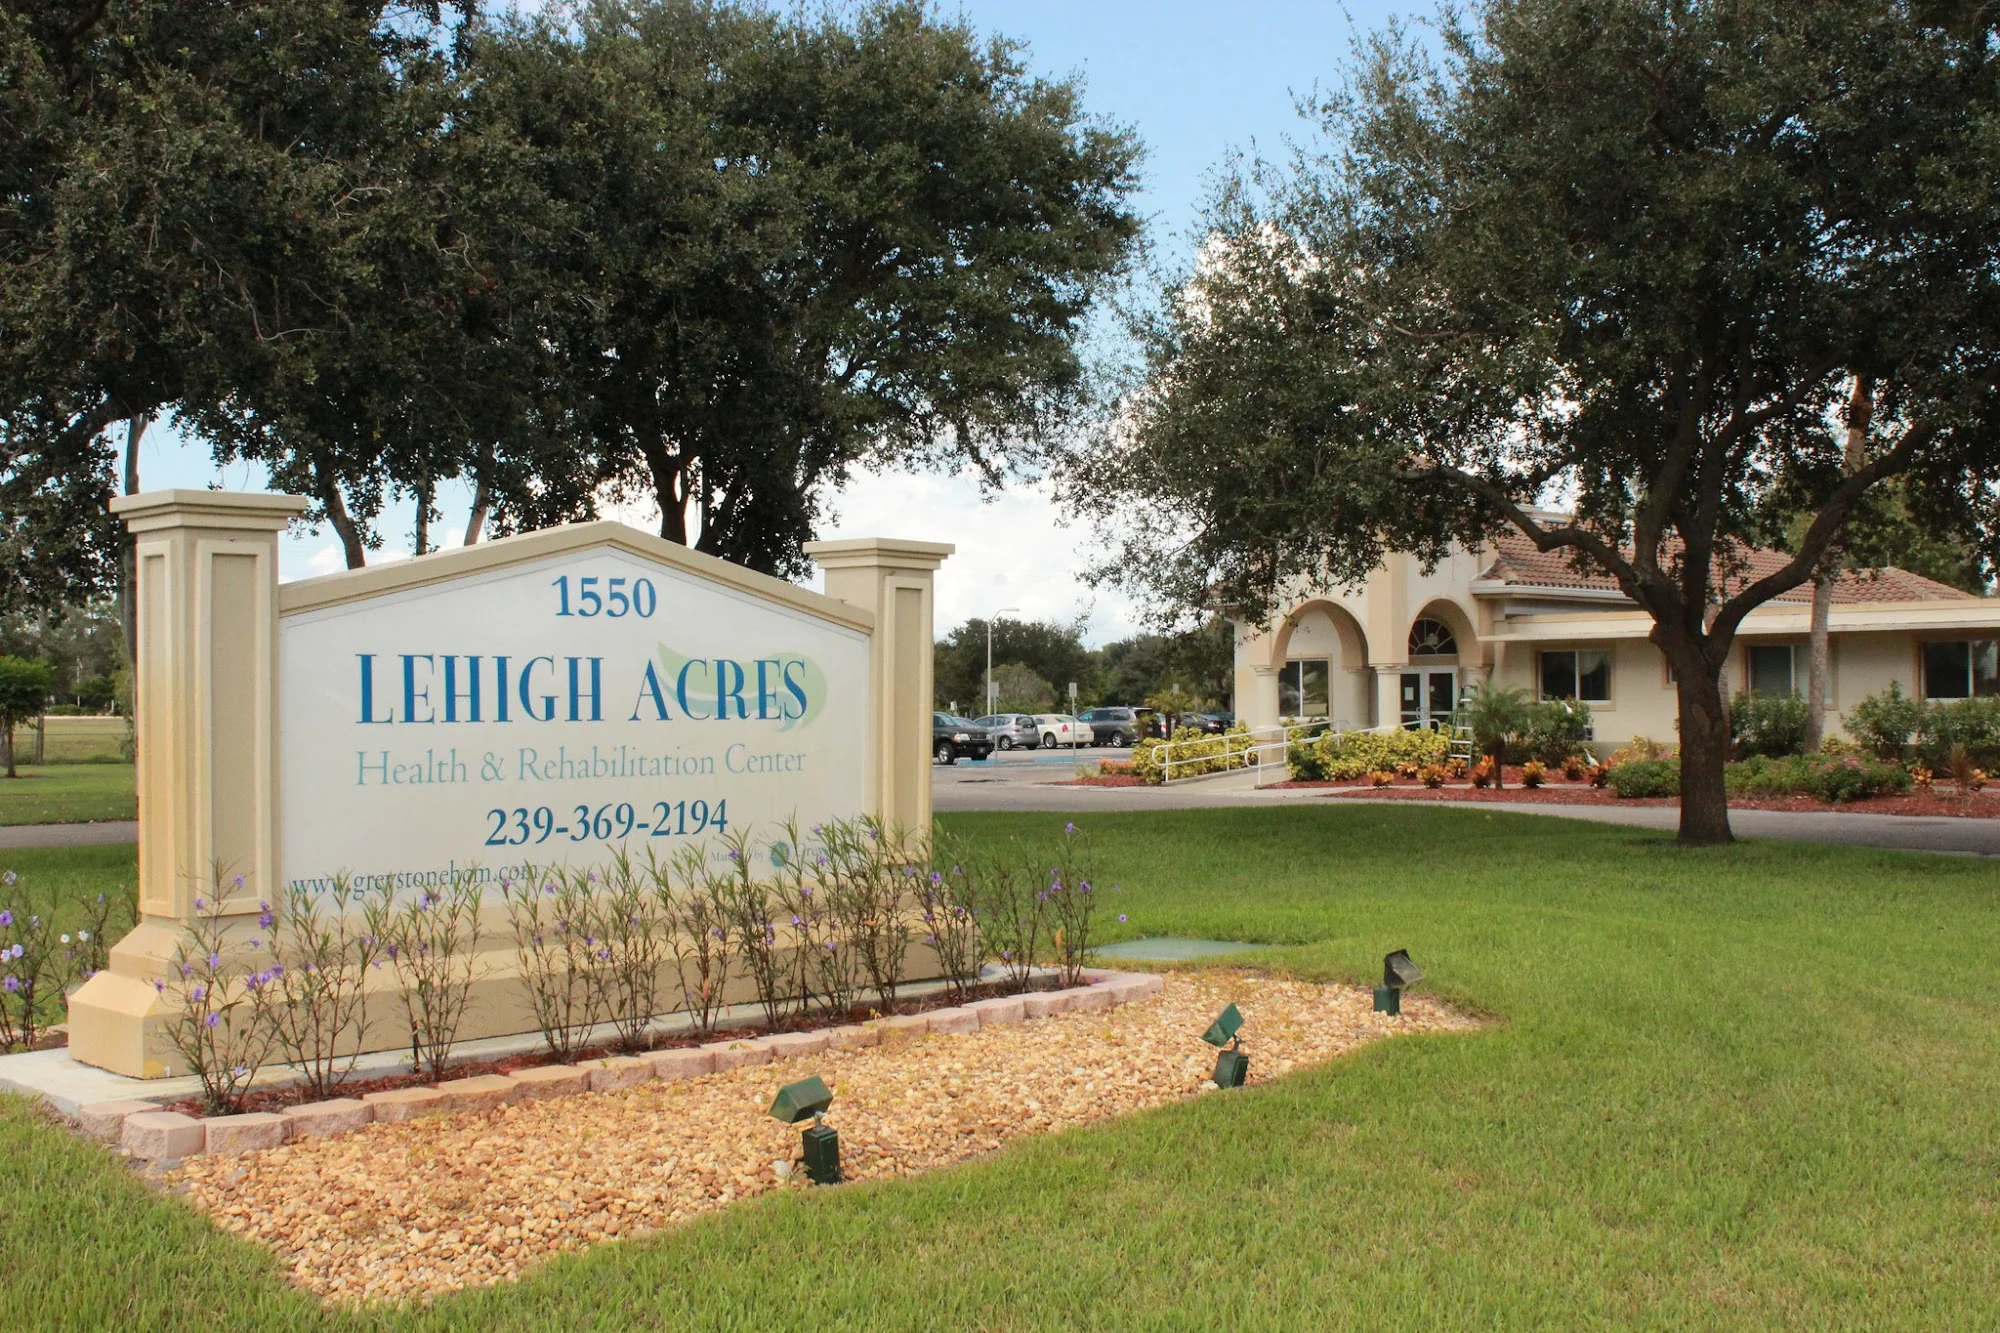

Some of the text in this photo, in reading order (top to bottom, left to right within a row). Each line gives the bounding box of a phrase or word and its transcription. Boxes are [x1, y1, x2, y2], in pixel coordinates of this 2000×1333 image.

[551, 575, 657, 618] 1550
[355, 653, 808, 725] LEHIGH ACRES
[356, 743, 806, 785] Health & Rehabilitation Center
[484, 797, 728, 846] 239-369-2194
